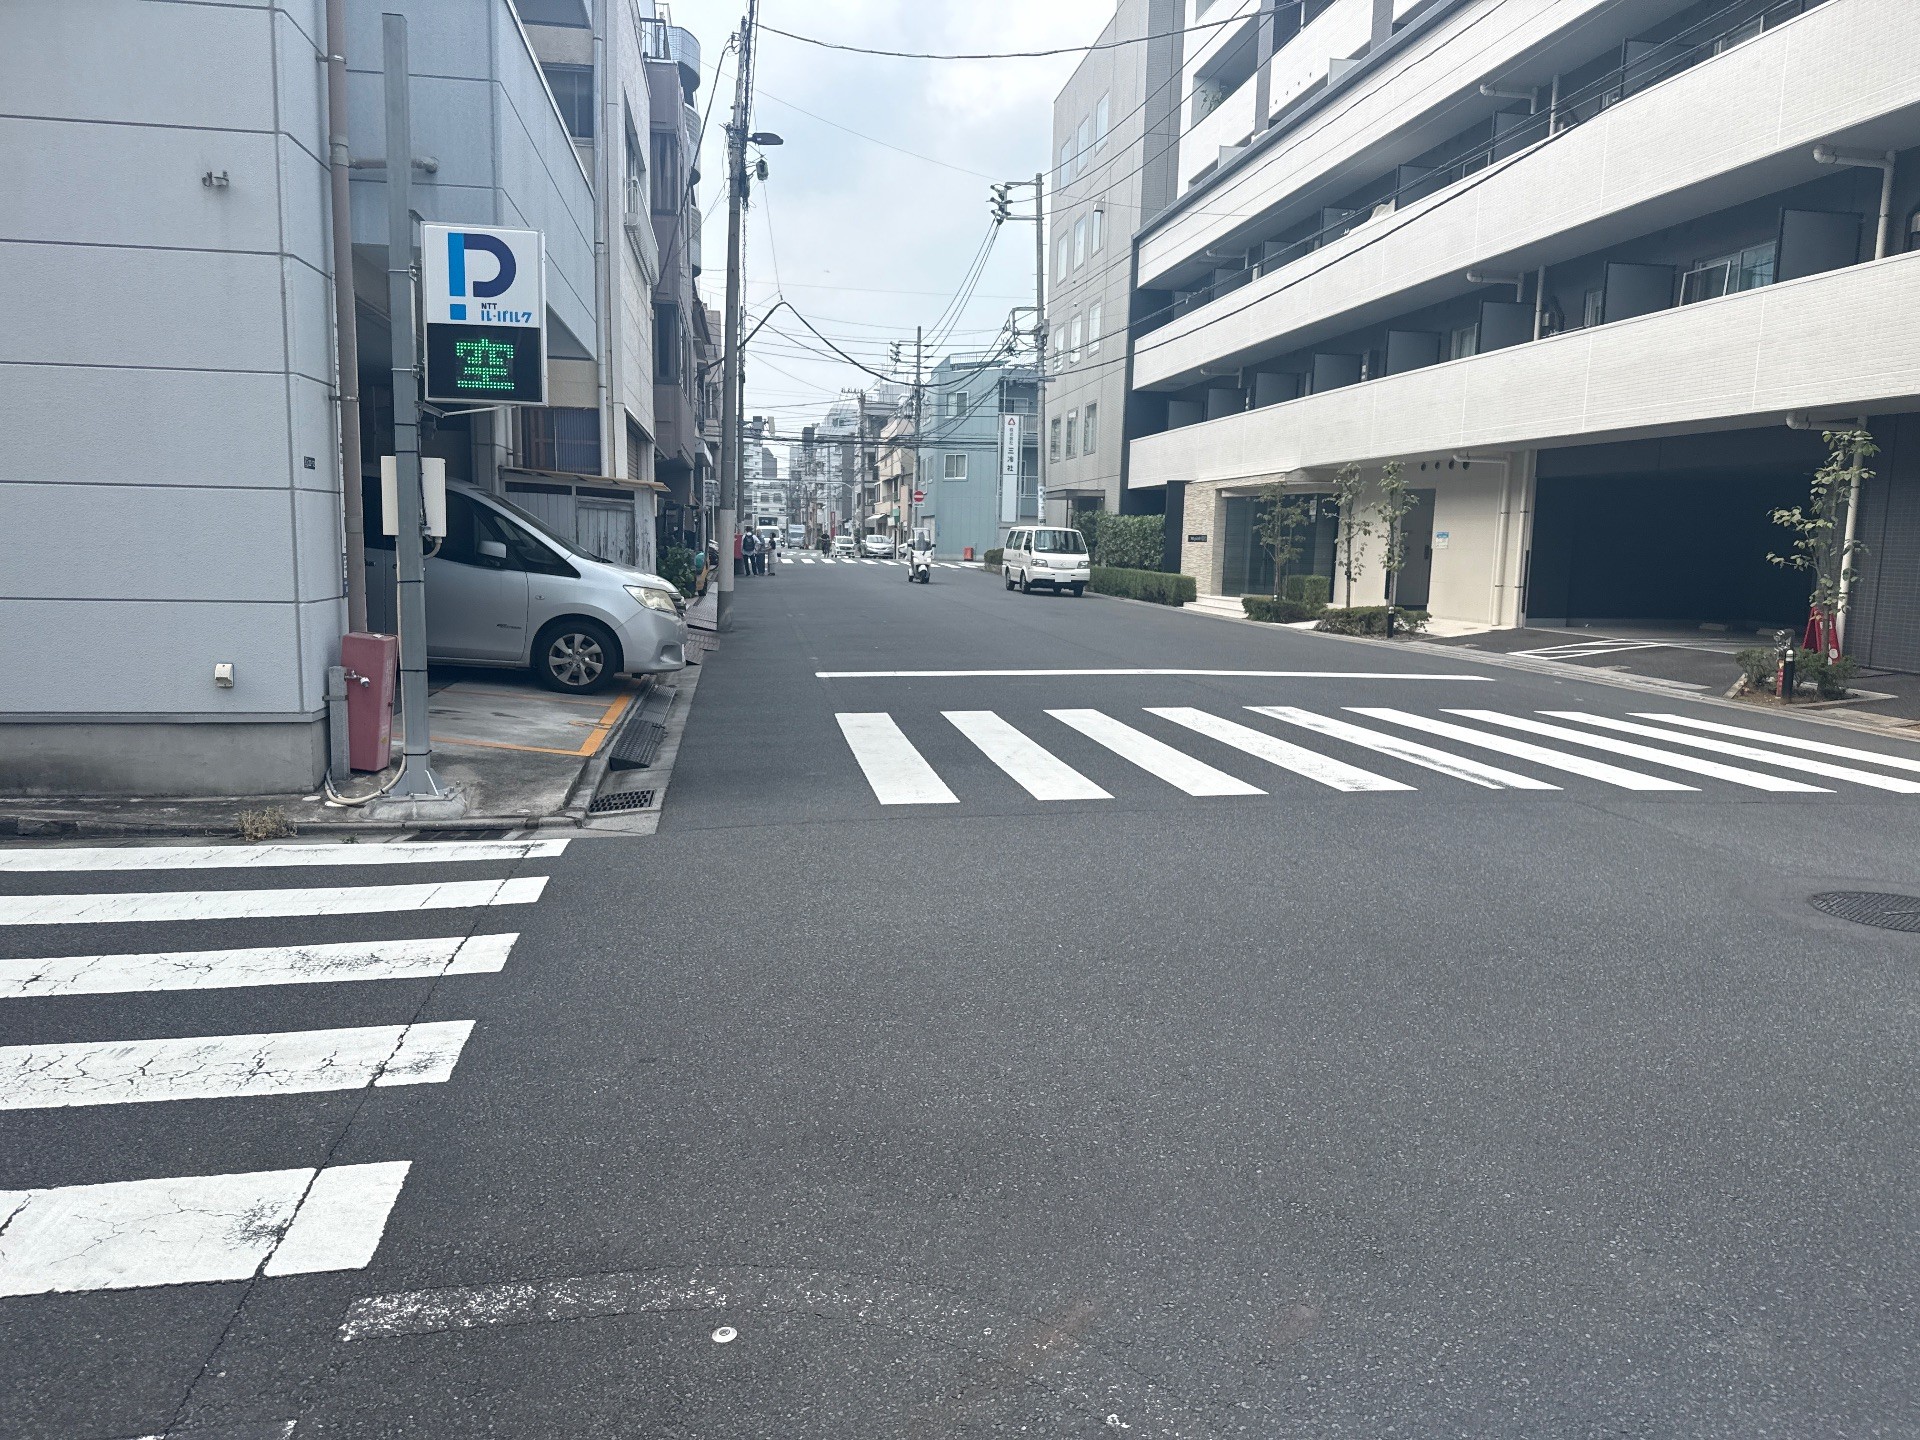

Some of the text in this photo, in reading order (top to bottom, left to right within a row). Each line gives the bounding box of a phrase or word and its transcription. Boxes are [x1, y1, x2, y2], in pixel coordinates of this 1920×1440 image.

[481, 310, 532, 323] ル・パルク
[456, 338, 515, 390] 空
